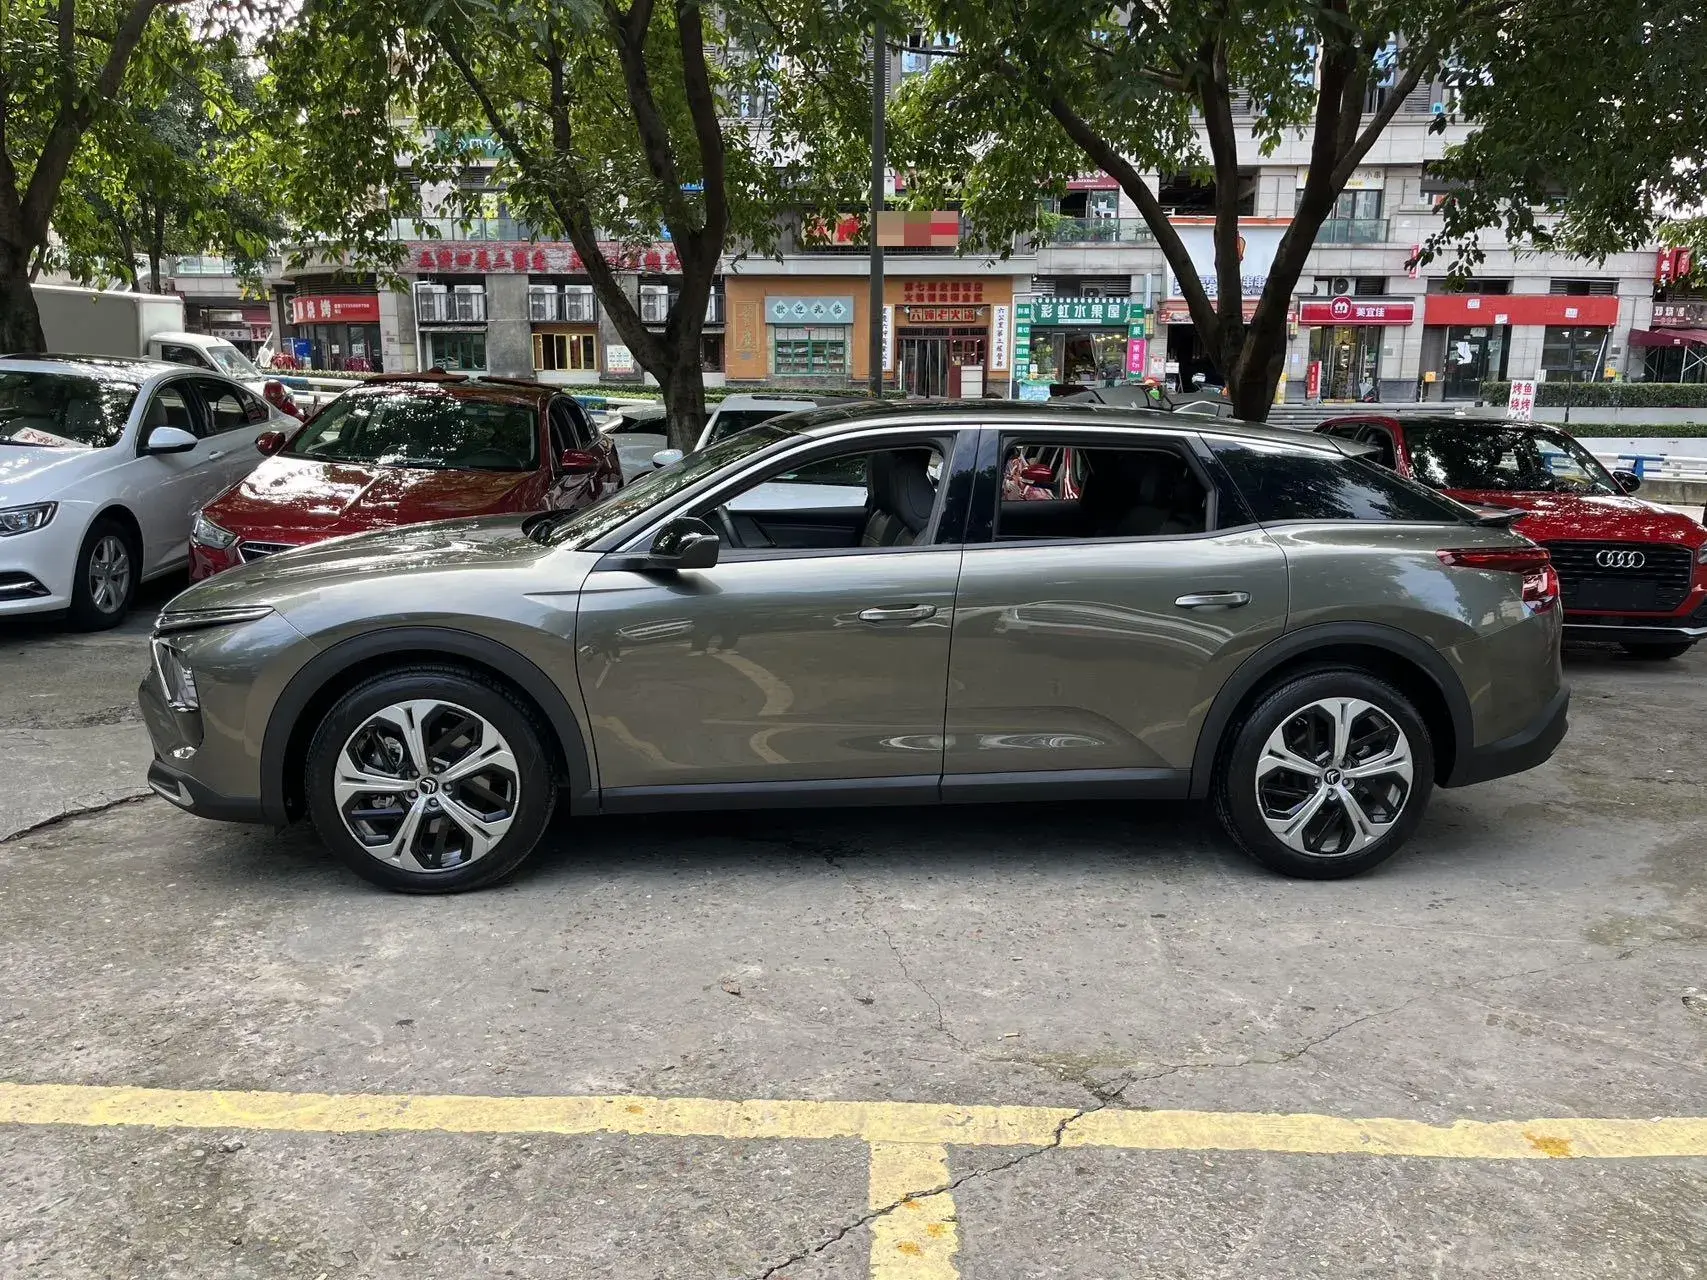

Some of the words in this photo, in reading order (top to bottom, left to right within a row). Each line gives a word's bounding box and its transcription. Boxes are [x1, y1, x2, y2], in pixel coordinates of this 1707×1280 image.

[1041, 305, 1120, 318] 彩虹水果屋
[1356, 307, 1386, 317] 美宜佳
[1512, 382, 1532, 395] 烤鱼
[1510, 398, 1531, 411] 烧烤
